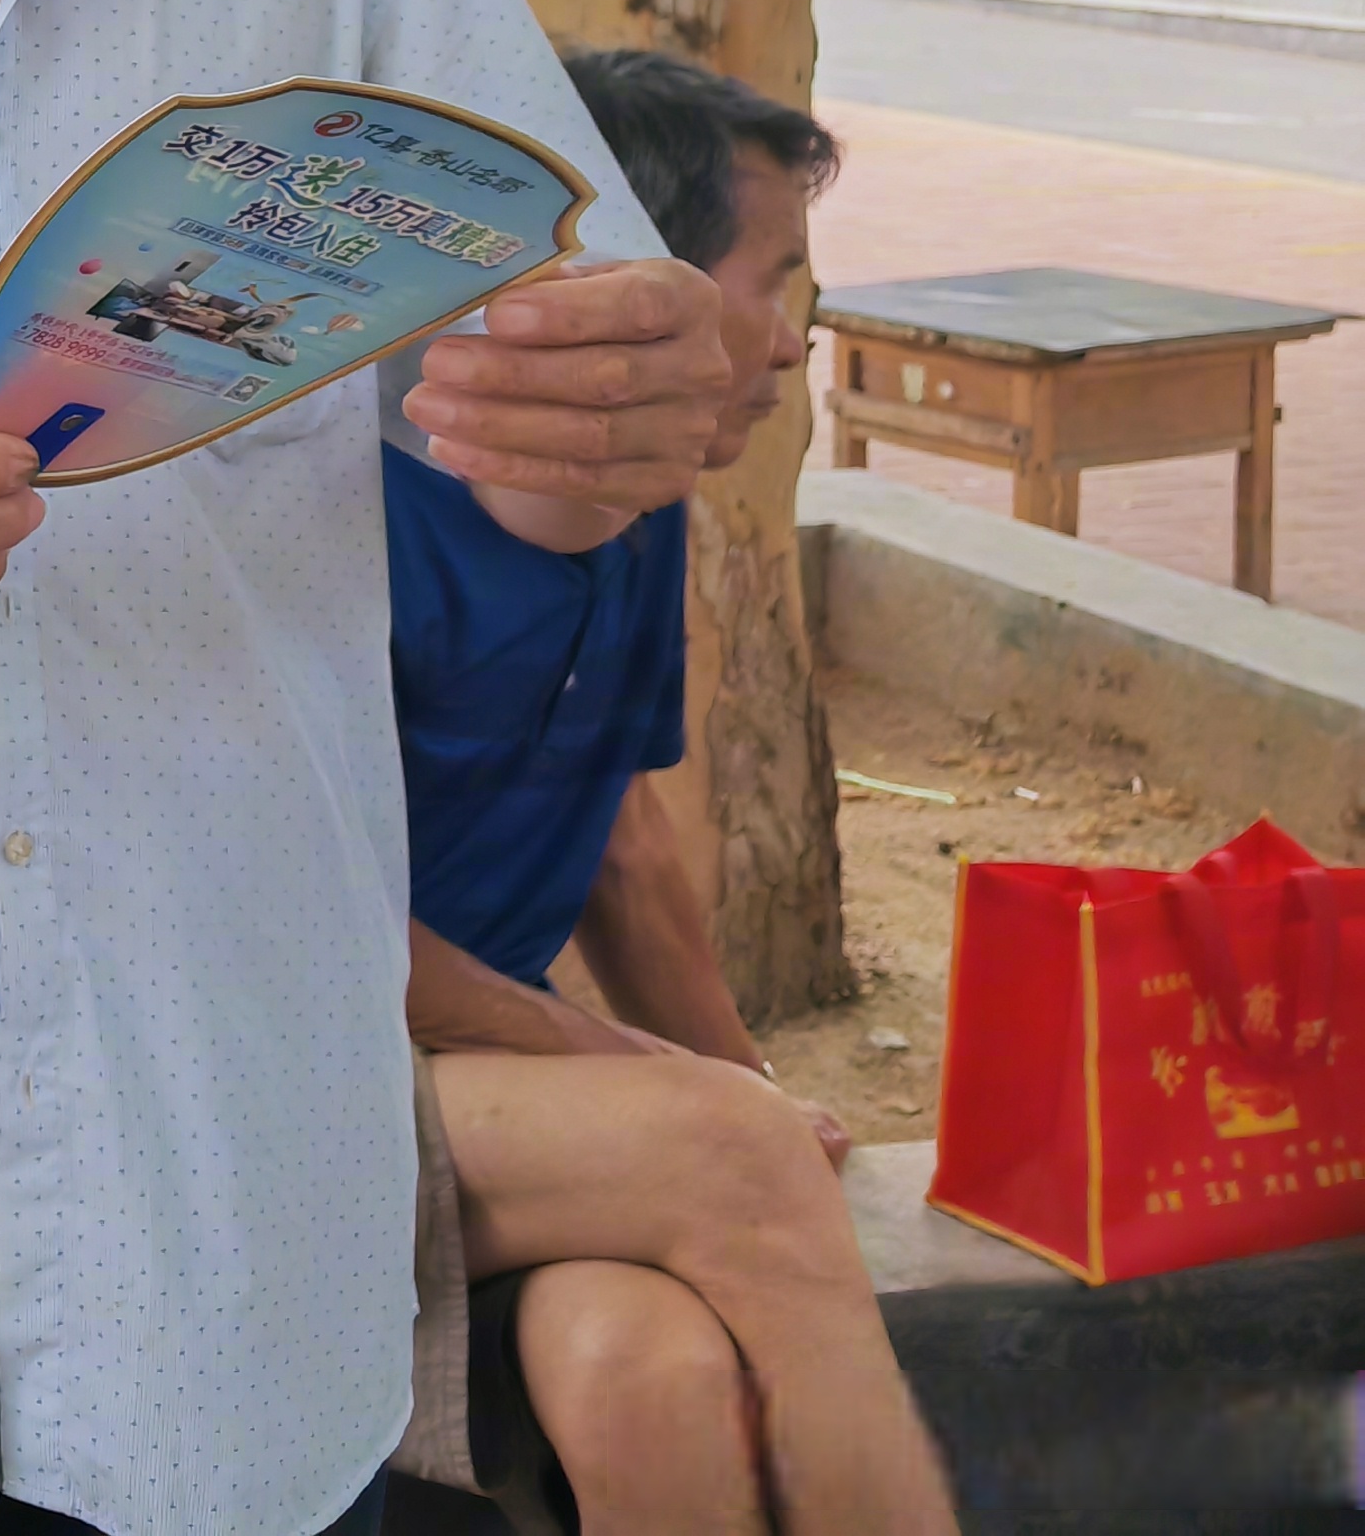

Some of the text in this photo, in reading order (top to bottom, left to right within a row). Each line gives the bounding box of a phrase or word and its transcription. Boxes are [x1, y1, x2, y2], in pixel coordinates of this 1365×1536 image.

[226, 197, 381, 268] 拎包入住
[25, 327, 67, 350] 7828
[64, 340, 107, 362] 9999
